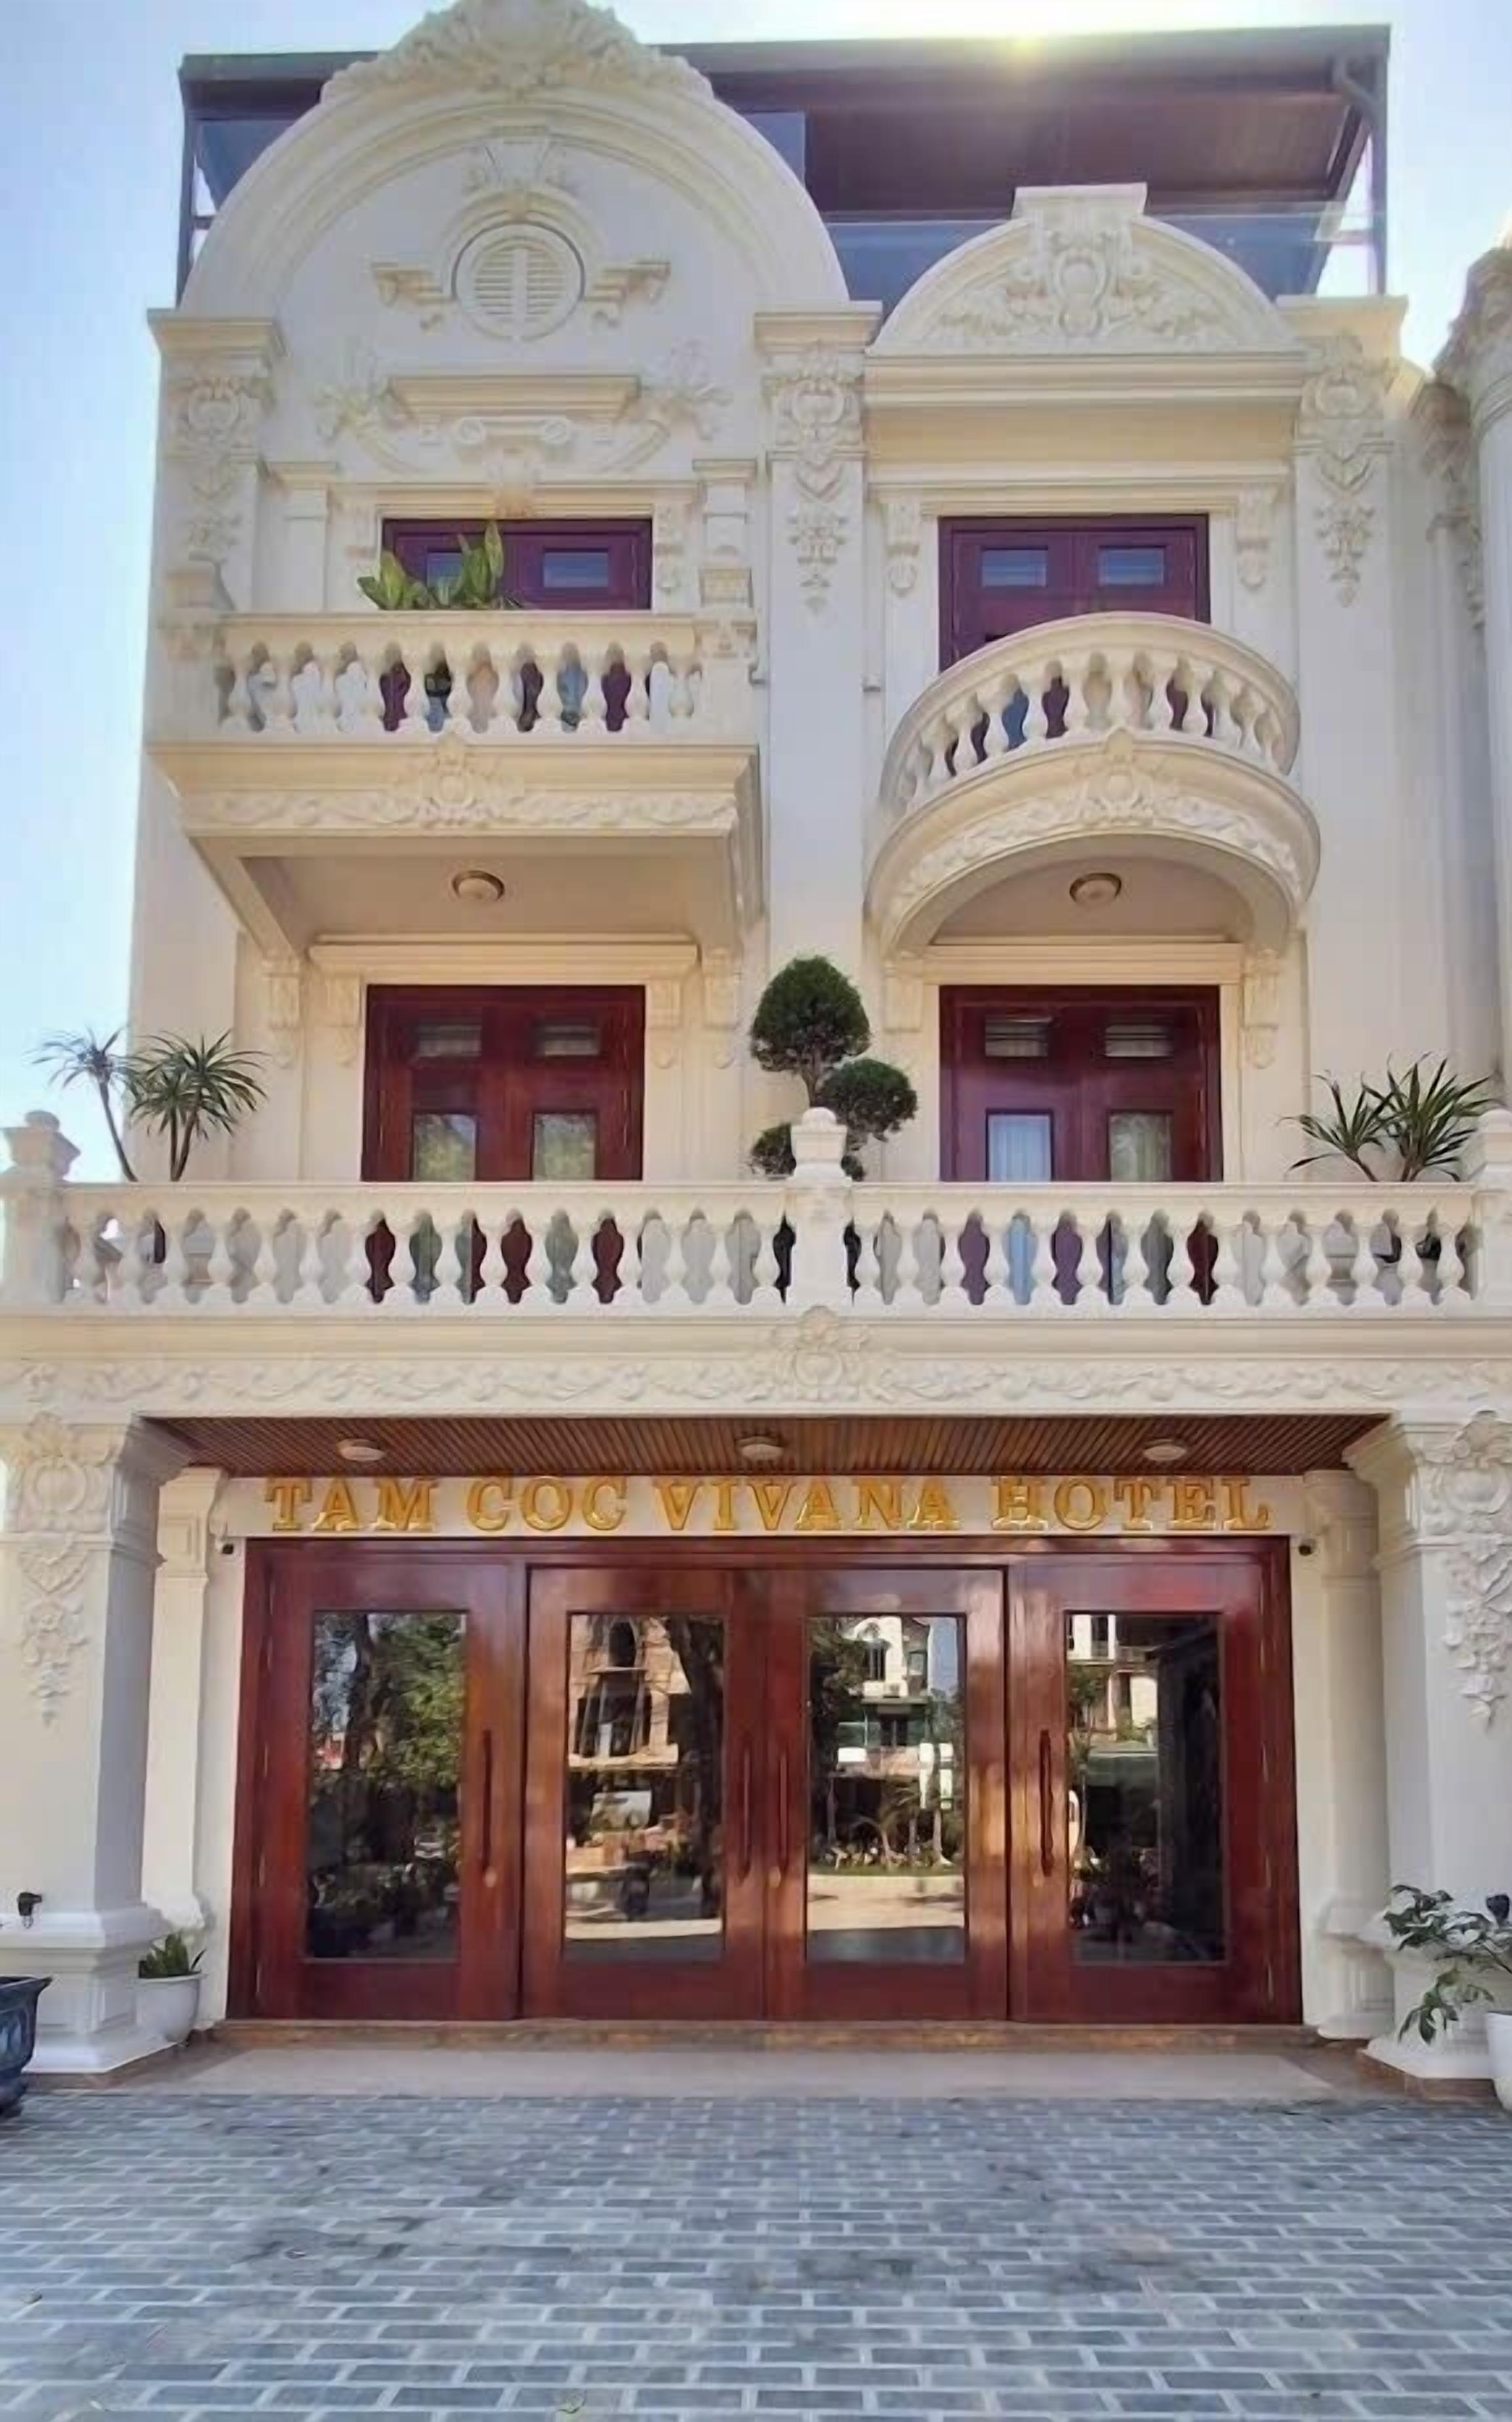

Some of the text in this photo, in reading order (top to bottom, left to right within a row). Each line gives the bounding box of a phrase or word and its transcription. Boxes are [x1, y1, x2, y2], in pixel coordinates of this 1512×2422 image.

[265, 1476, 1271, 1531] TAM COC VIVANA HOTEL
